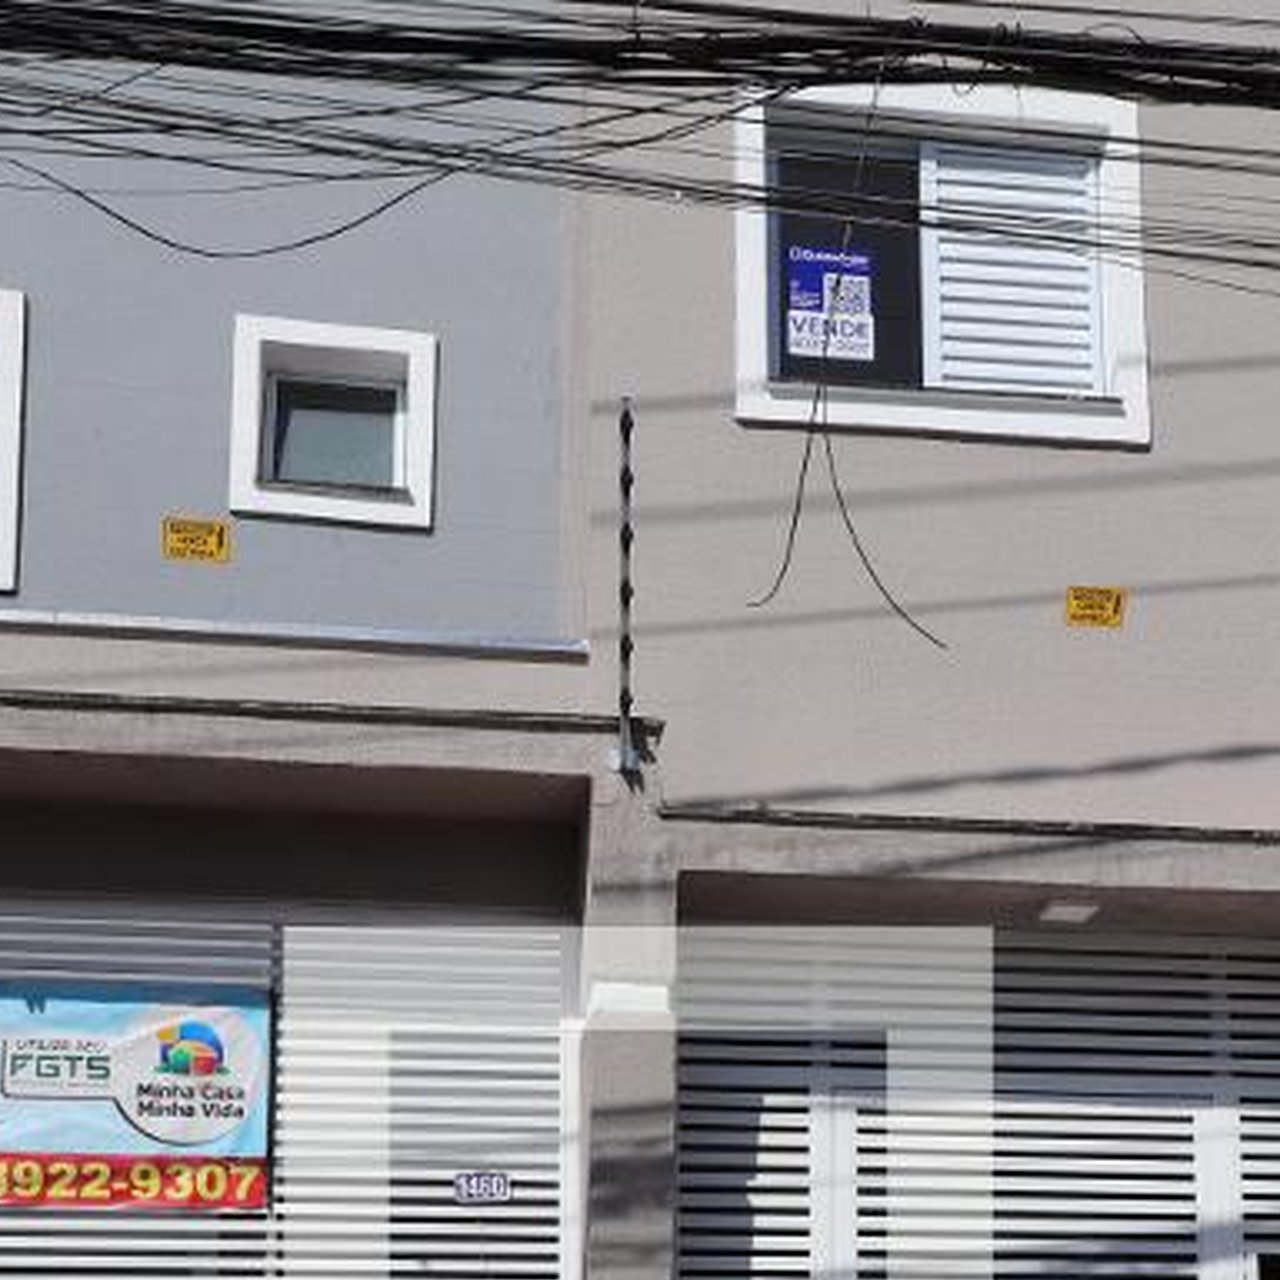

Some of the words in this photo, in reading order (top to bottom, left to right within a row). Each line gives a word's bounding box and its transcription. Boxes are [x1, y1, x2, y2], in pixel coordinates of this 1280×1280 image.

[9, 1054, 112, 1079] FGTS
[137, 1082, 195, 1100] Minha
[201, 1083, 245, 1102] Casa
[137, 1100, 196, 1118] Minha
[202, 1102, 245, 1120] Vida
